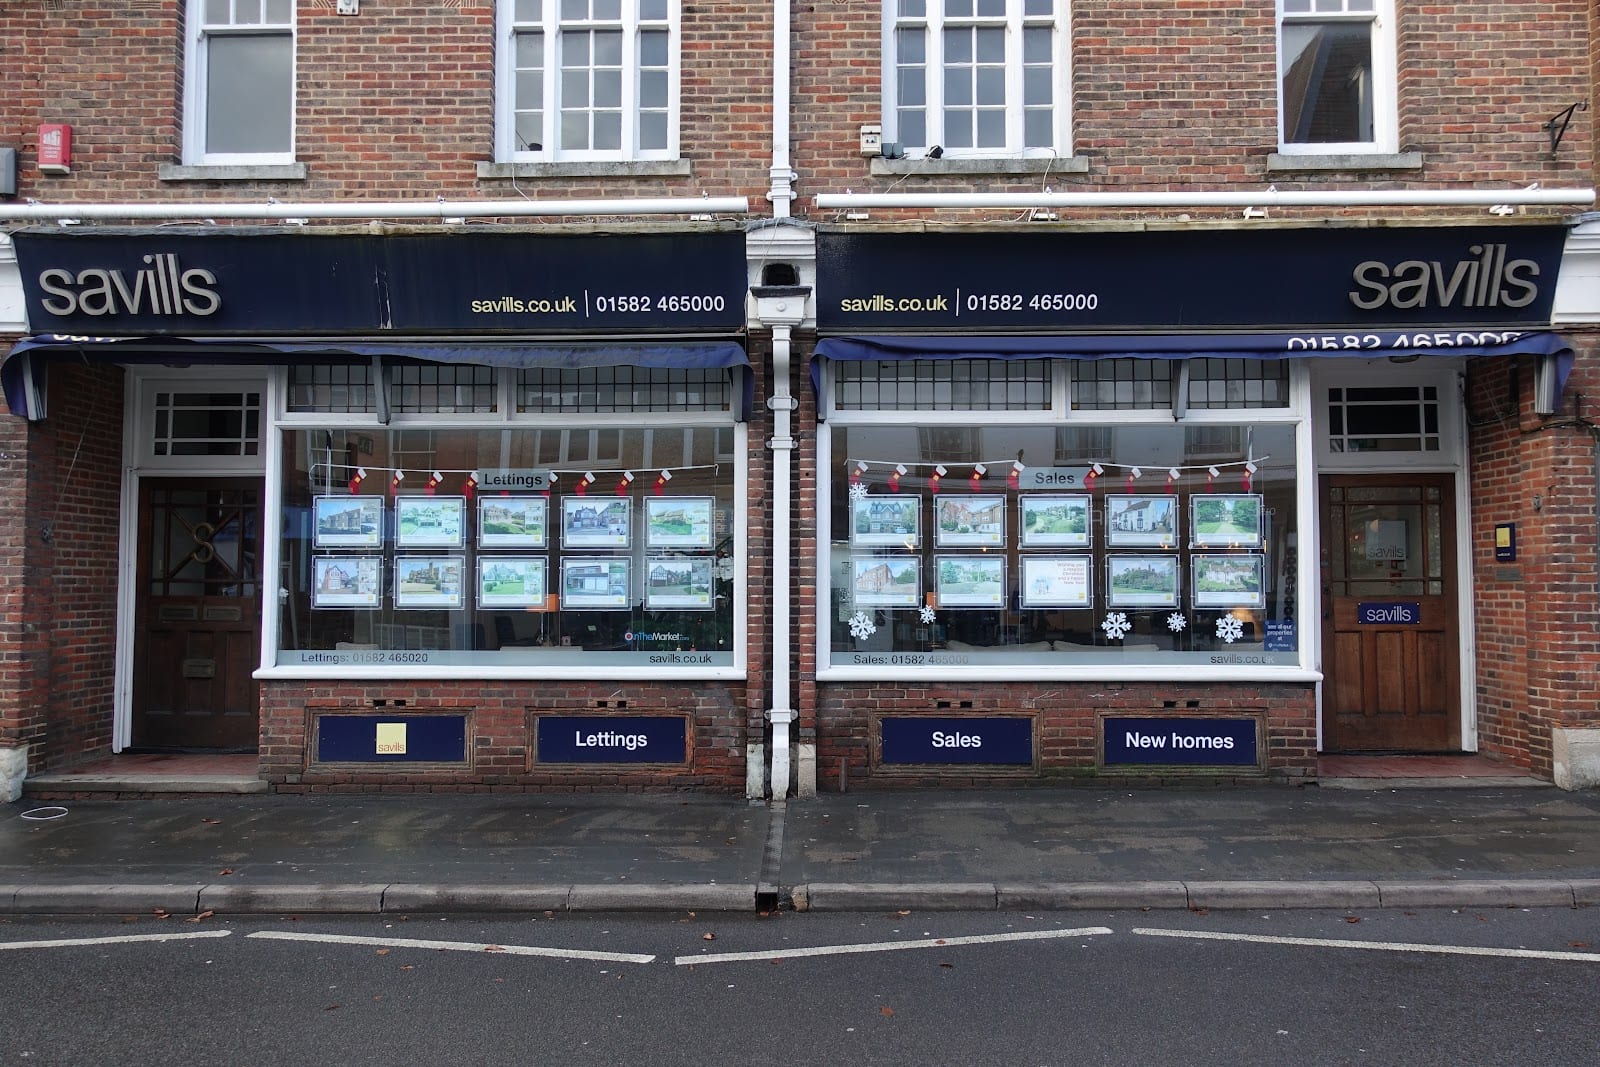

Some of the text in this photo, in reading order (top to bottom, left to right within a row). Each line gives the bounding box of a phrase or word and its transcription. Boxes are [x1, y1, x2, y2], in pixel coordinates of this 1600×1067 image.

[39, 253, 222, 316] savills
[1349, 243, 1540, 310] savills
[471, 295, 725, 313] savills.co.uk 01582 465000
[841, 293, 1098, 312] savills.co.uk 01582 465000
[484, 473, 543, 488] Lettings
[1035, 472, 1075, 484] Sales
[1368, 544, 1405, 558] savills
[1366, 605, 1412, 622] savills
[301, 652, 428, 664] Lettings: 01582 465020
[649, 652, 712, 664] savills.co.uk
[854, 654, 969, 665] Sales: 01582 465000
[378, 741, 405, 753] savills
[575, 730, 648, 750] Lettings
[931, 731, 982, 748] Sales
[1125, 732, 1234, 749] New homes
